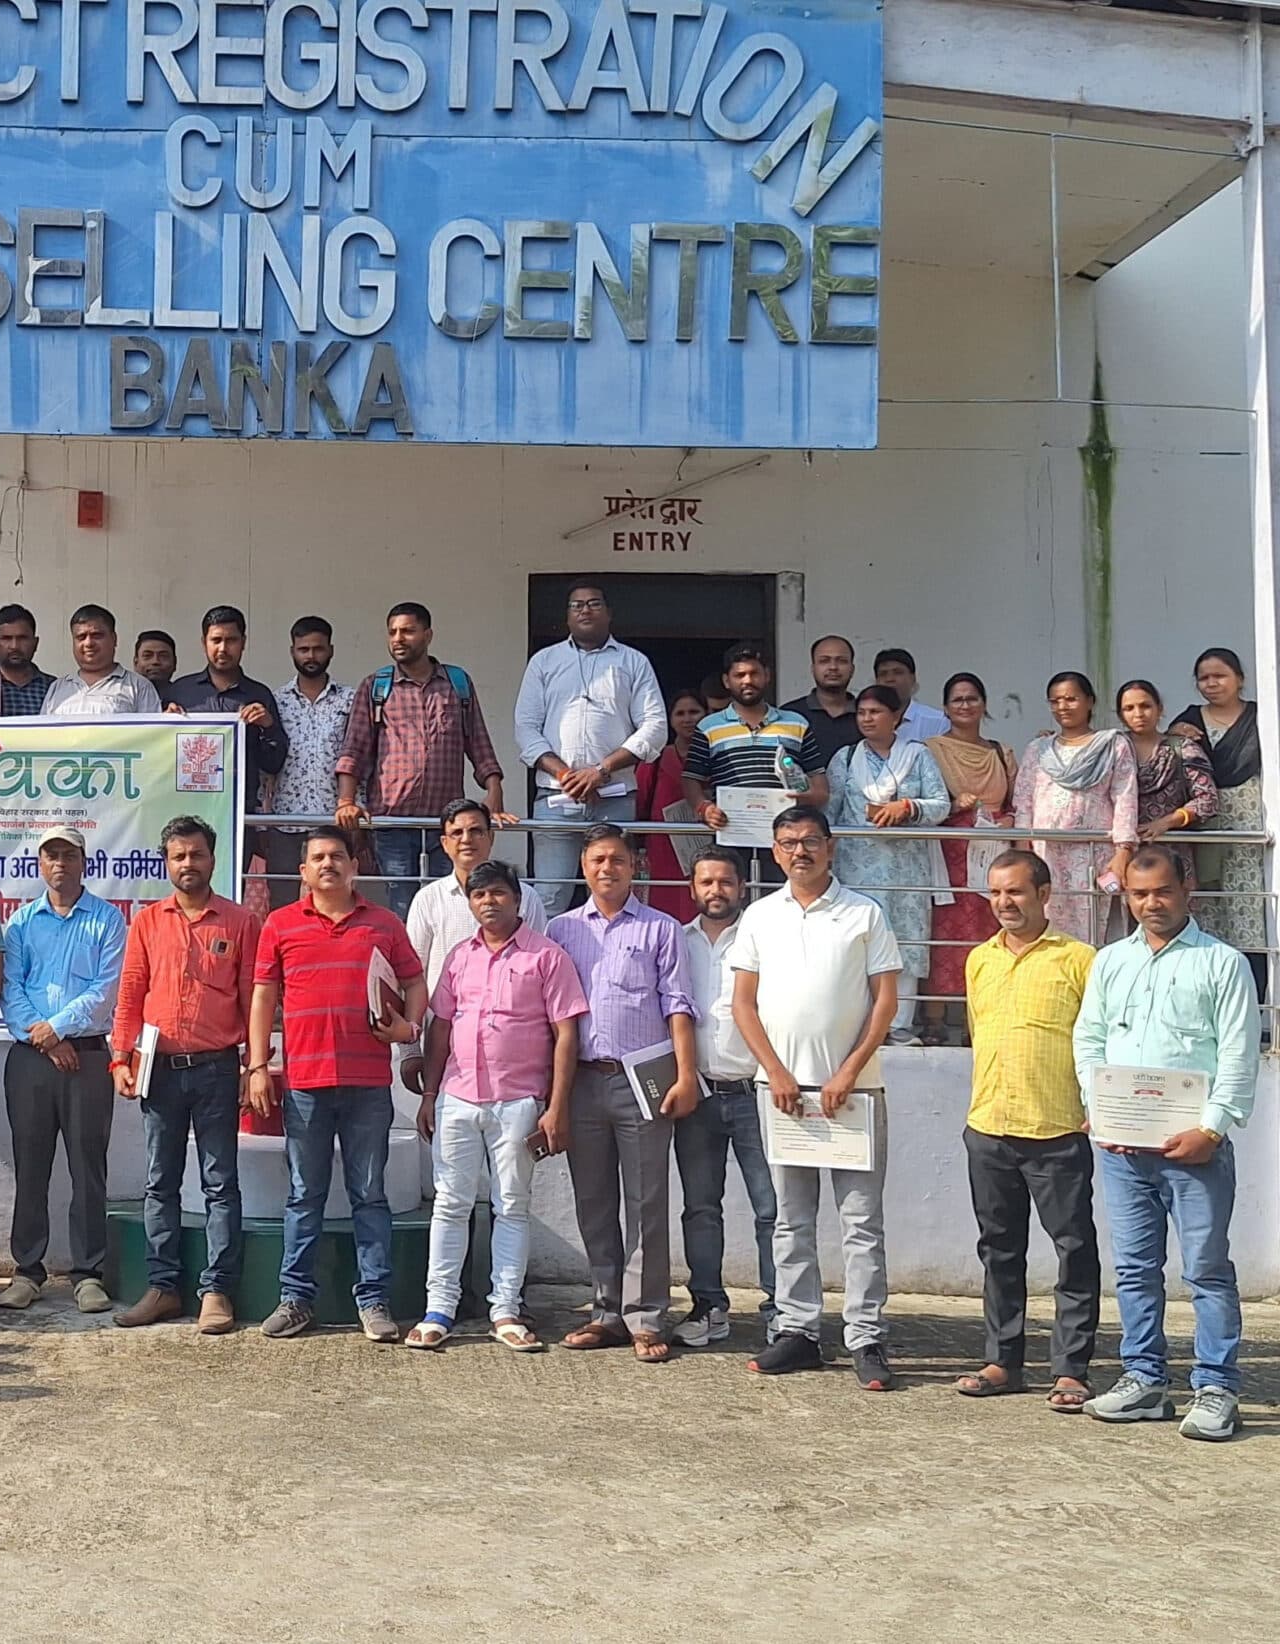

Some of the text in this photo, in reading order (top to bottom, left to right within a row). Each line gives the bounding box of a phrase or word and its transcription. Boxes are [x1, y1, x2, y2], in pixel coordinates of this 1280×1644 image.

[126, 0, 881, 218] REGISTRATION
[166, 114, 373, 211] CUM
[427, 217, 881, 346] CENTRE
[109, 336, 414, 436] BANKA
[603, 488, 704, 525] प्रवेश द्वार
[613, 531, 692, 552] ENTRY
